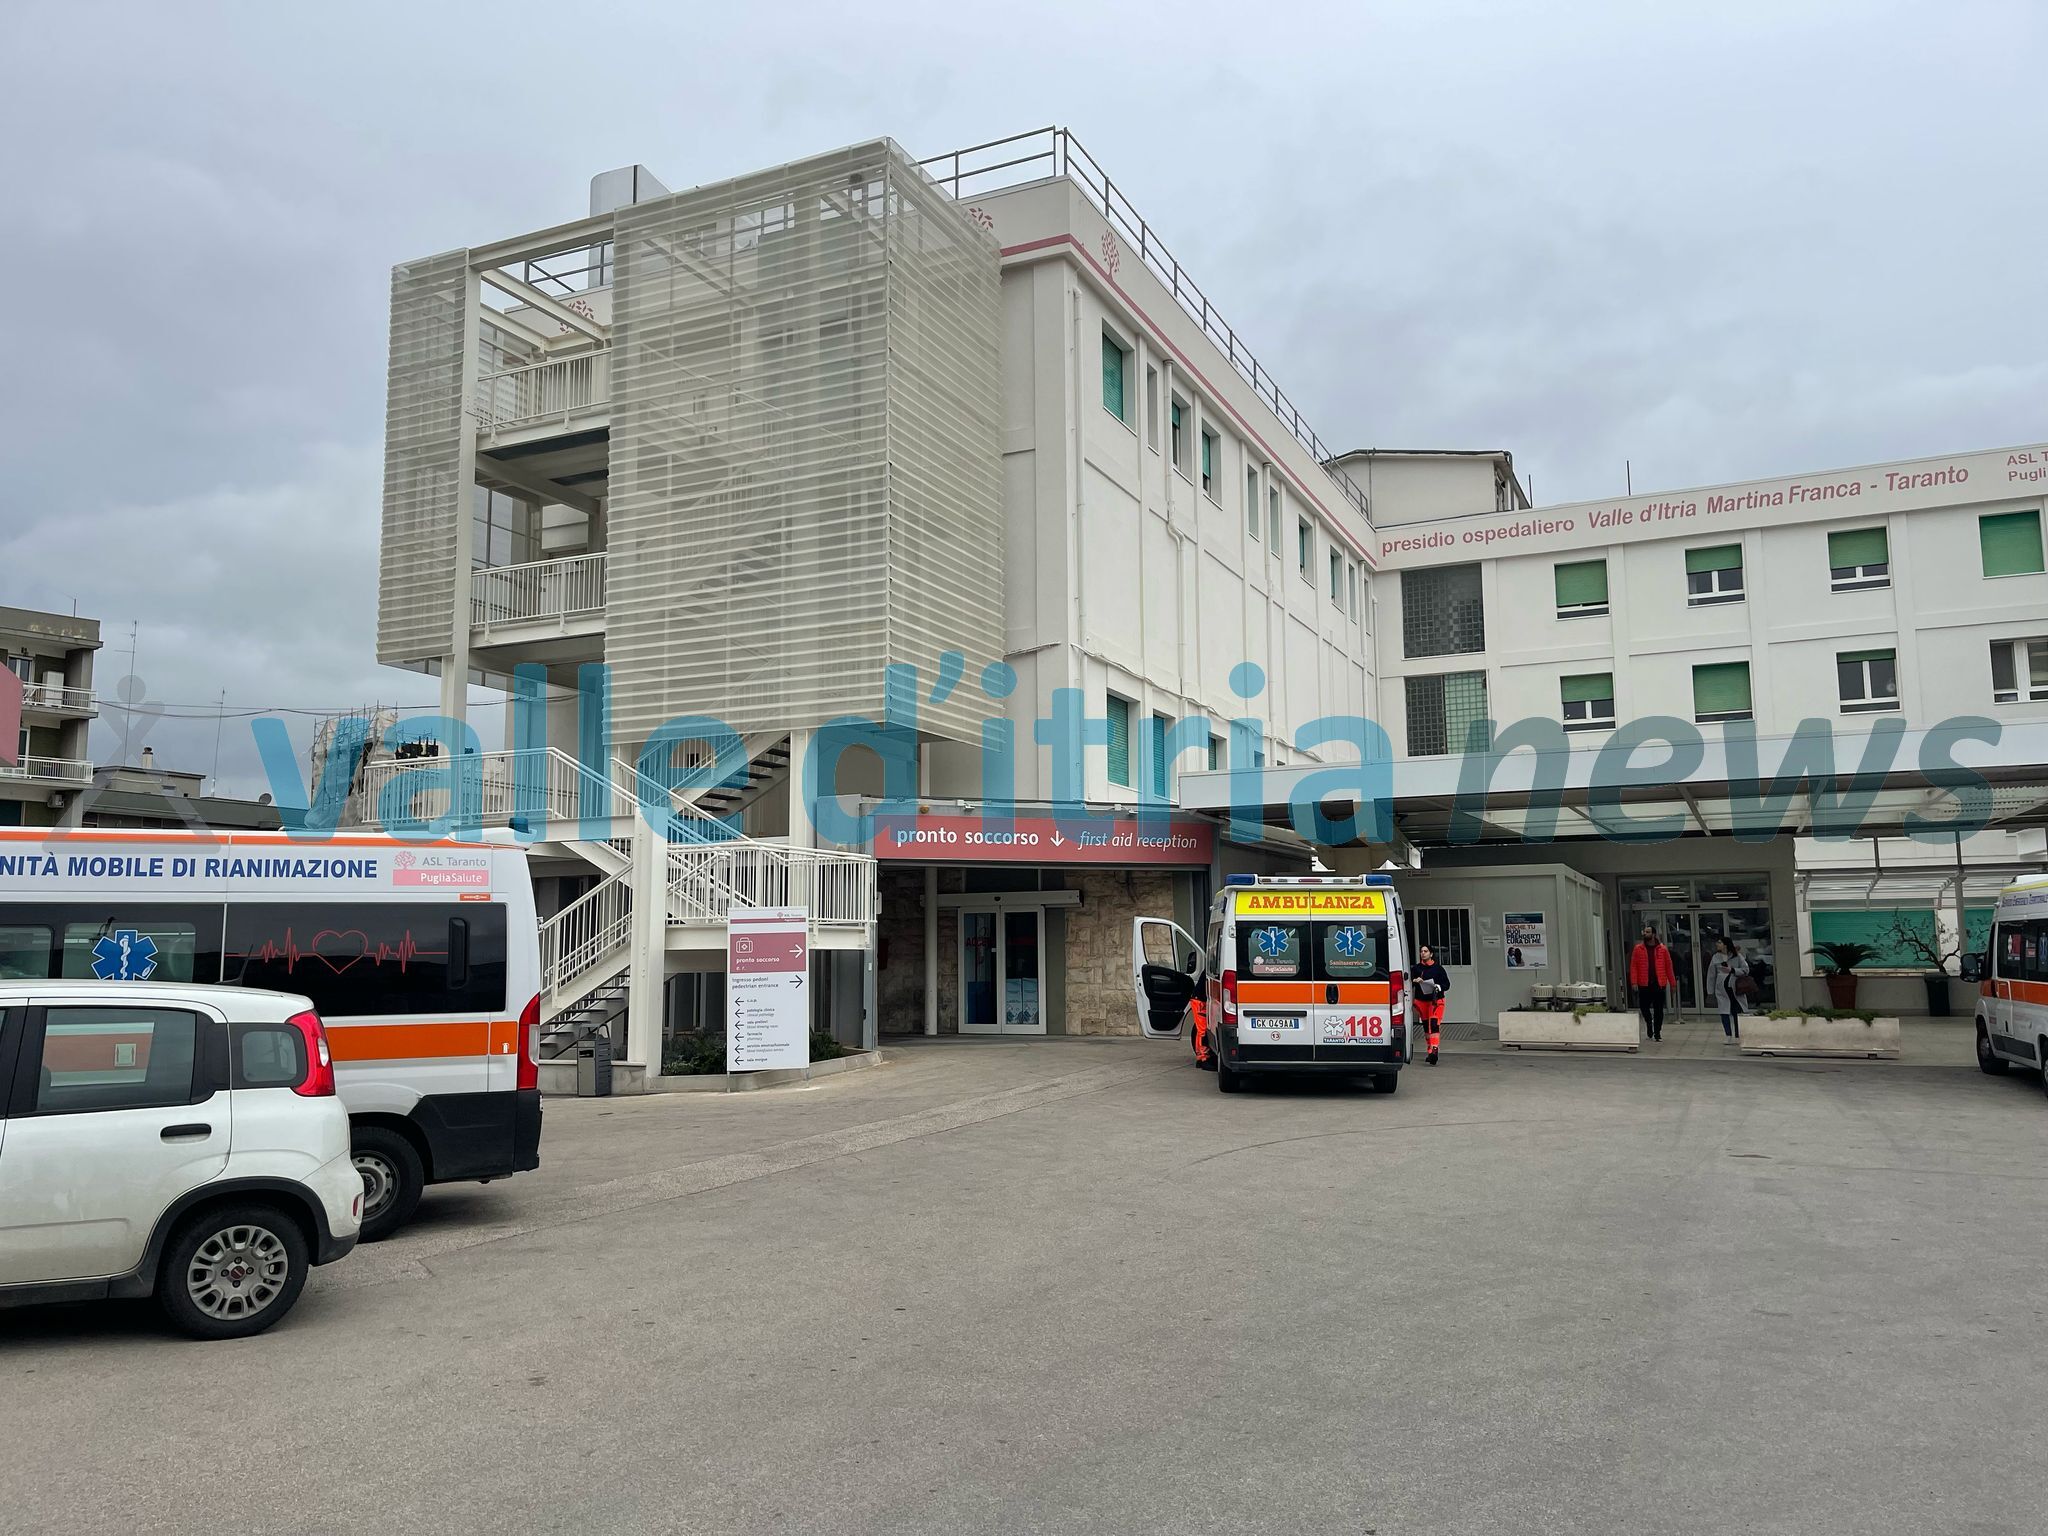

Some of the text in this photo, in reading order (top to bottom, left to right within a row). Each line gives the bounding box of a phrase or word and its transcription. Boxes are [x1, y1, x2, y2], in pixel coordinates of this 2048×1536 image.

[2007, 452, 2038, 466] ASL
[1381, 531, 1455, 556] presidio
[1462, 517, 1575, 545] ospedaliero
[1588, 507, 1633, 529] Valle
[1639, 499, 1698, 522] d'Itria
[1706, 489, 1784, 514] Martina
[1788, 481, 1862, 504] Franca
[1884, 465, 1970, 491] Taranto
[896, 827, 1198, 852] pronto soccorso first aid reception
[67, 856, 164, 878] MOBILE
[172, 857, 197, 878] DI
[204, 858, 378, 879] RIANIMAZIONE
[422, 856, 487, 867] ASL Taranto
[420, 872, 483, 885] PugliaSalute
[1248, 895, 1375, 909] AMBULANZA
[1256, 1019, 1295, 1028] GK 049AA
[1345, 1015, 1383, 1037] 118
